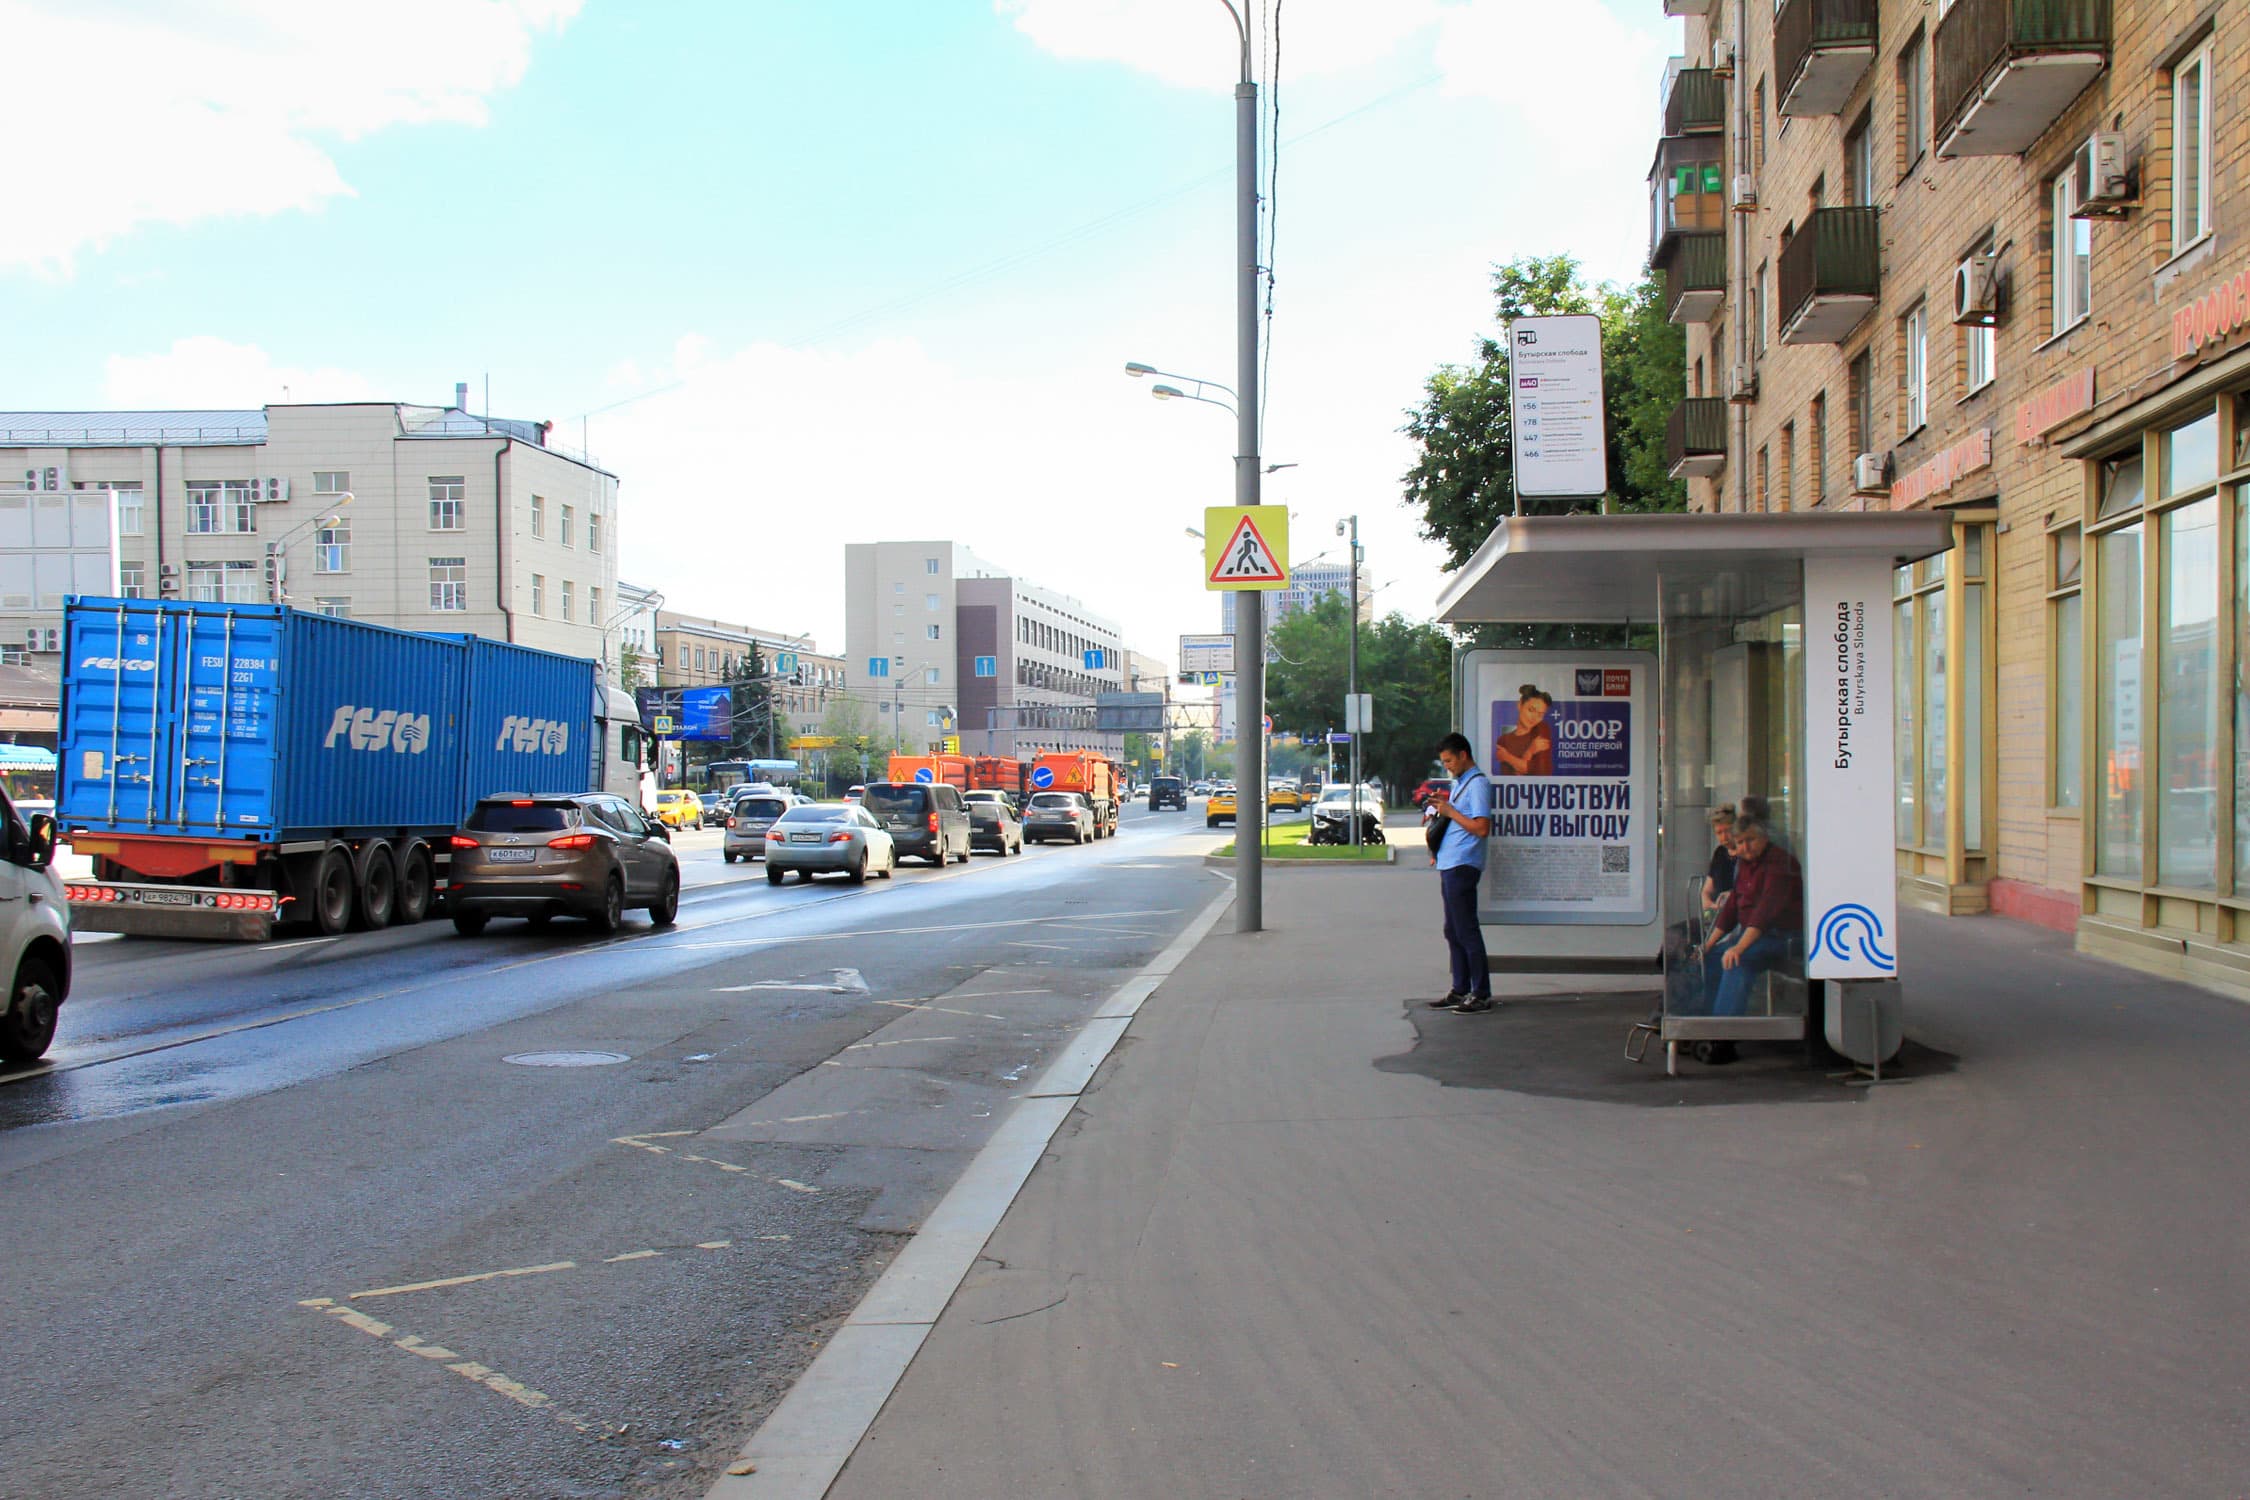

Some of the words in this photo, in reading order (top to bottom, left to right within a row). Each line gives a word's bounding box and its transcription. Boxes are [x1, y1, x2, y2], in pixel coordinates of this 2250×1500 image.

[1518, 351, 1557, 359] Бутырская
[1558, 349, 1588, 357] слобода
[1834, 601, 1851, 673] слобода
[1854, 601, 1864, 648] Sloboda
[81, 656, 155, 671] FESCO
[202, 656, 224, 668] FESU
[234, 658, 265, 670] 228384
[232, 671, 254, 683] 22G1
[1854, 652, 1866, 715] Butyrskaya
[323, 705, 430, 754] FESCO
[496, 715, 568, 755] FESCO
[1835, 677, 1852, 769] Бутырская
[1558, 741, 1587, 750] ПОСЛЕ
[1588, 741, 1623, 751] ПЕРВОЙ
[1558, 750, 1598, 759] ПОКУПКИ
[1491, 780, 1630, 810] ПОЧУВСТВУЙ
[1491, 814, 1546, 837] НАШУ
[1550, 814, 1630, 840] ВЫГОДУ
